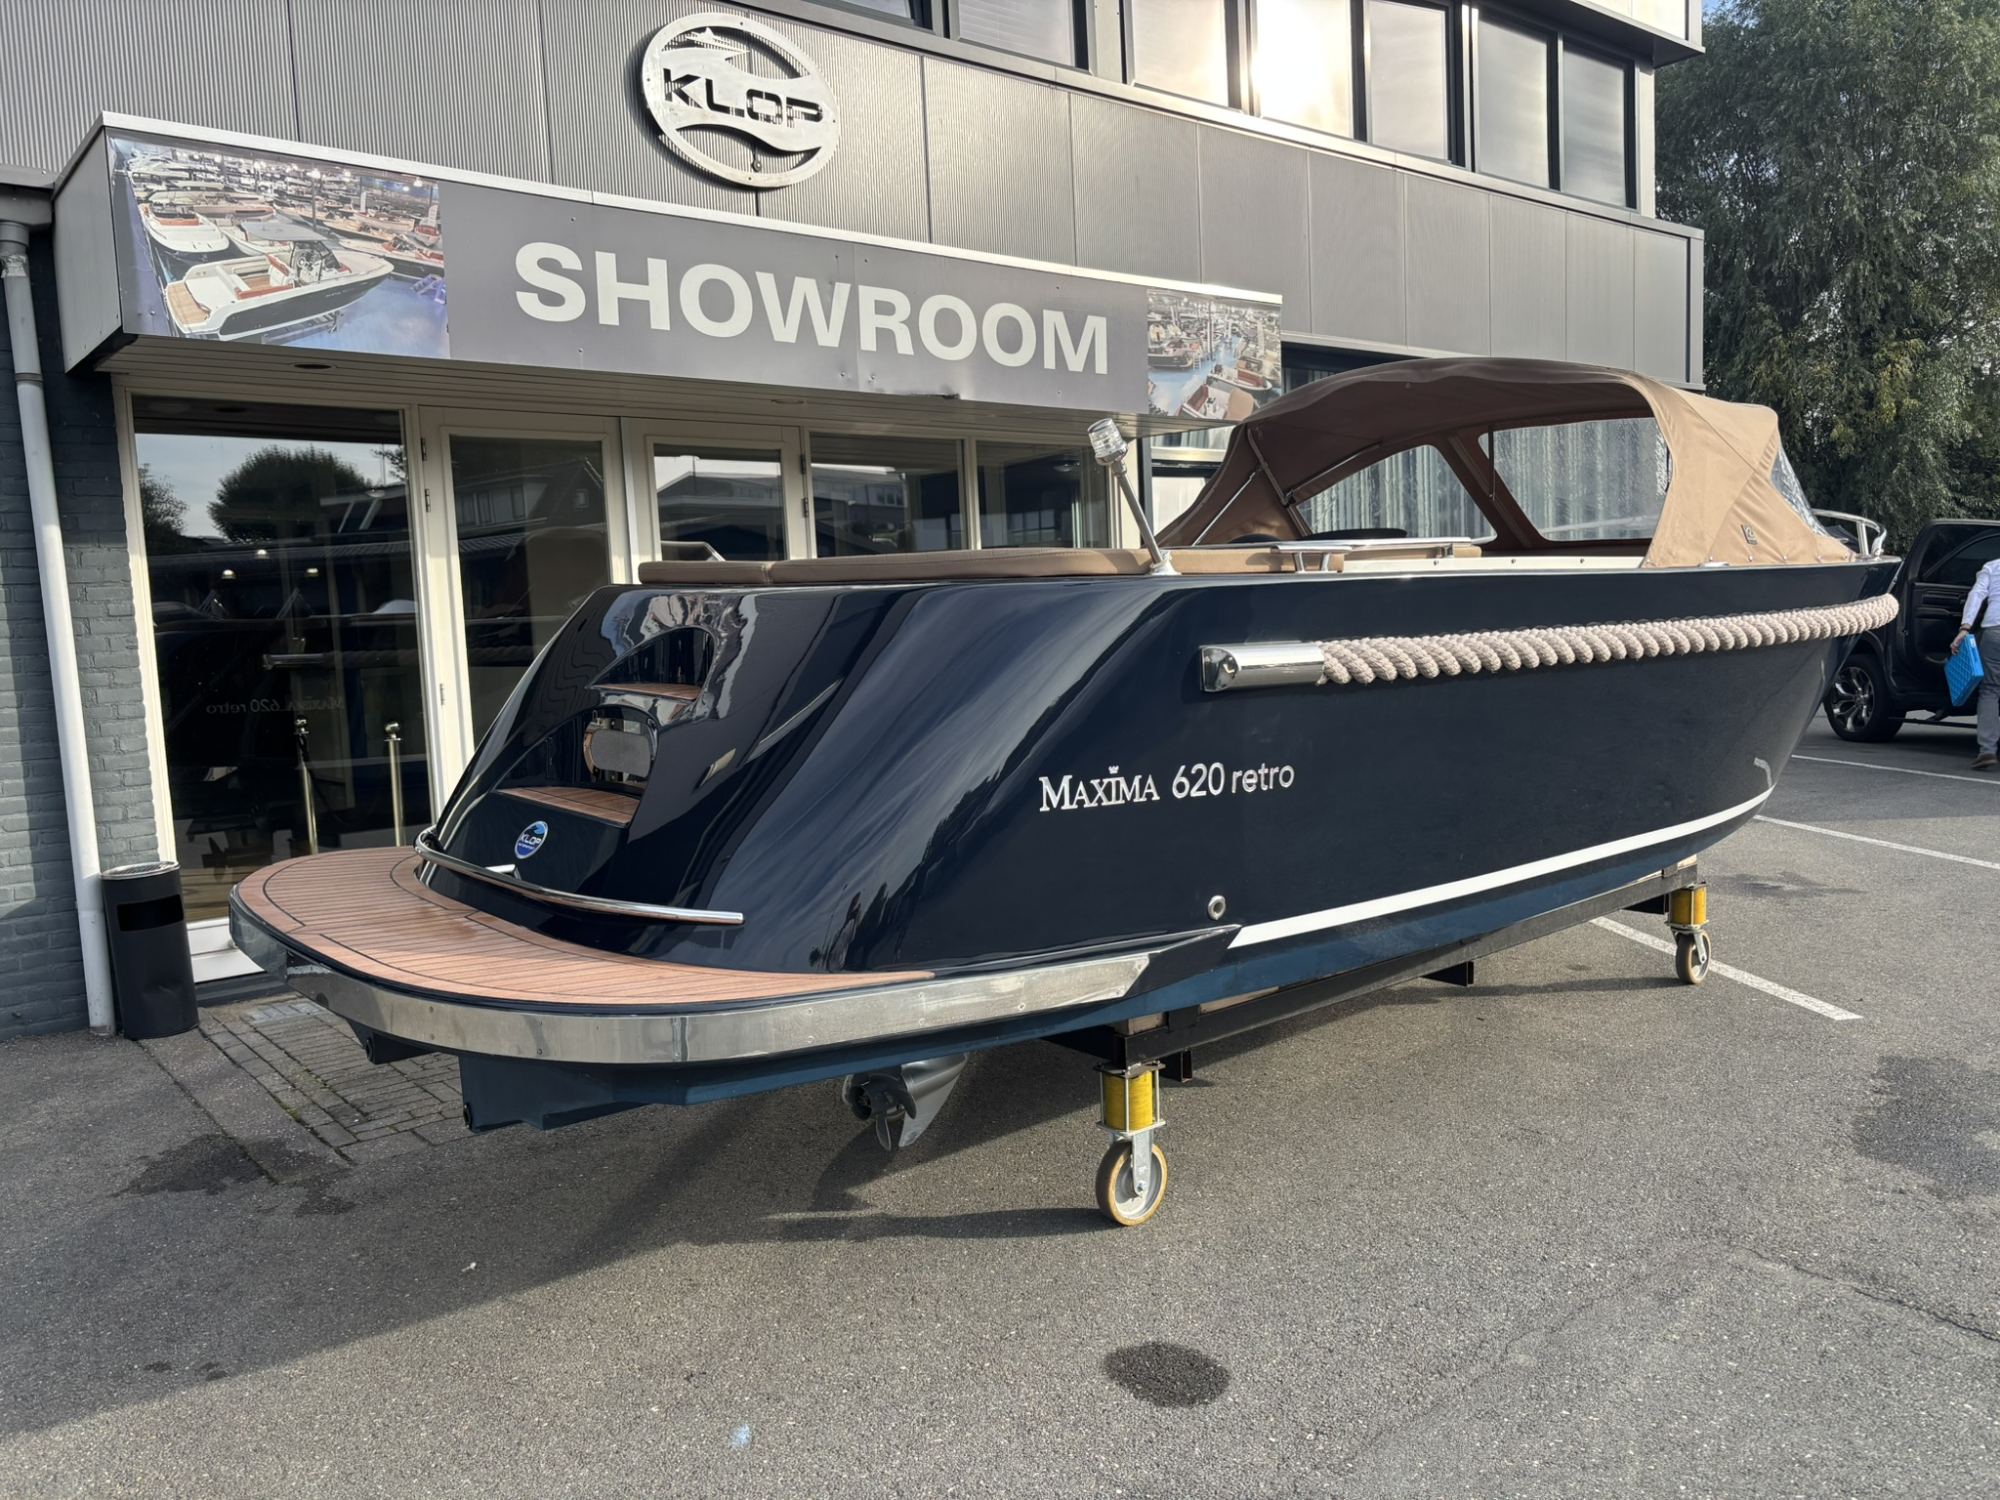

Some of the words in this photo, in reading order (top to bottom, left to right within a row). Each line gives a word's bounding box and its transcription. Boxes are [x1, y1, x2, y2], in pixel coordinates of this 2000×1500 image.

[663, 68, 823, 128] KLOP
[515, 241, 1108, 375] SHOWROOM
[1038, 774, 1160, 812] MAXIMA
[1171, 762, 1225, 799] 620
[1231, 763, 1295, 793] retro
